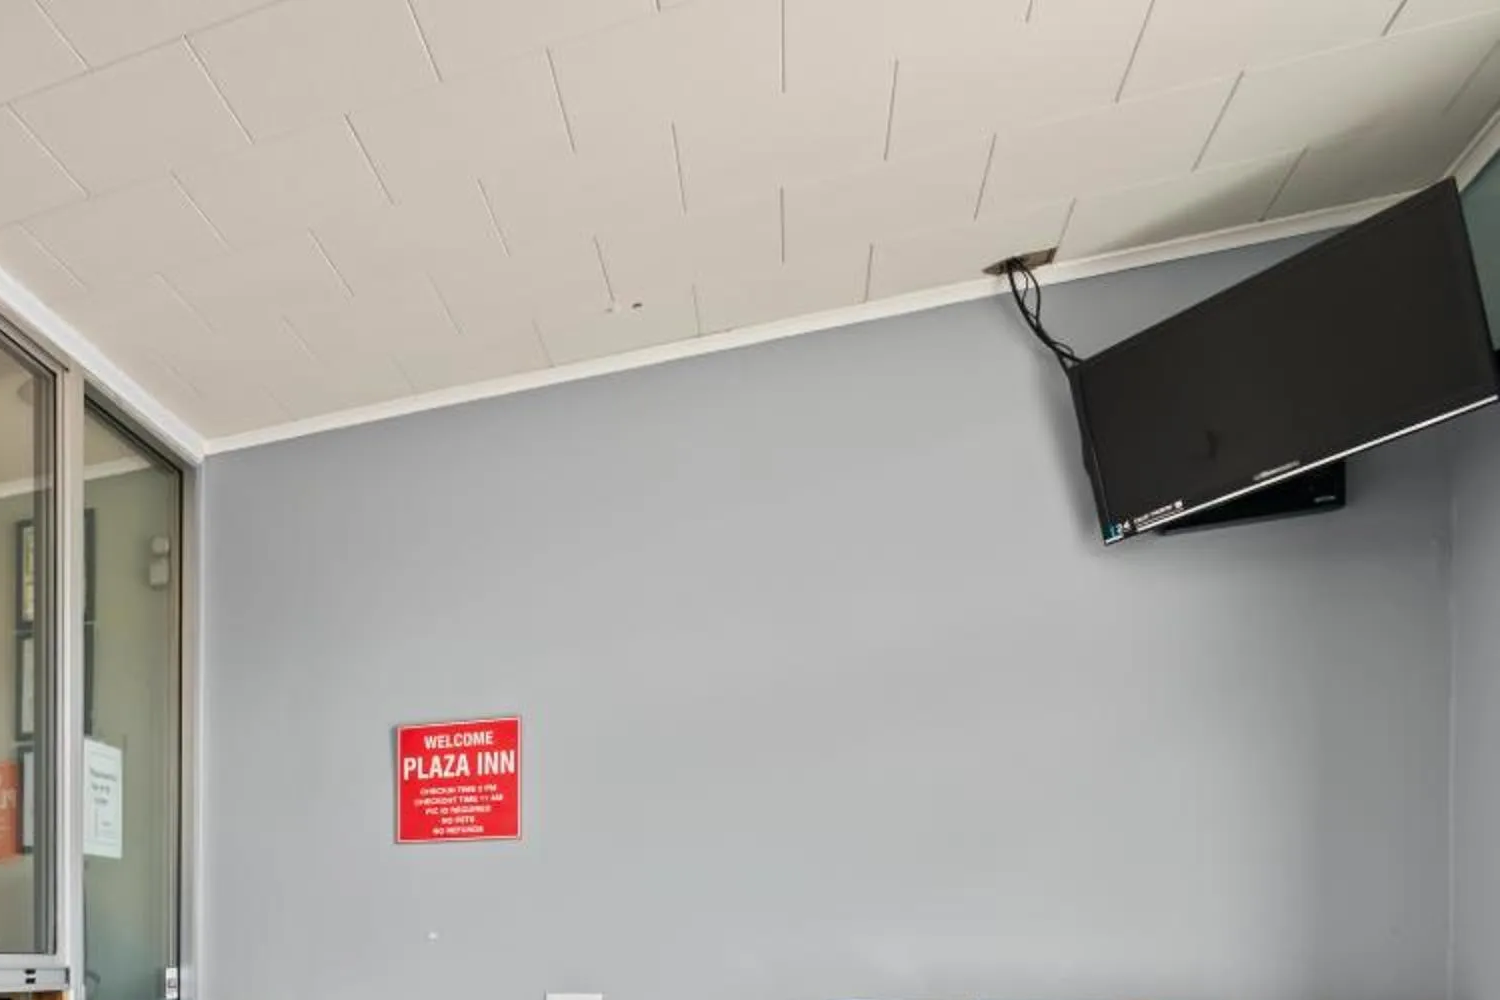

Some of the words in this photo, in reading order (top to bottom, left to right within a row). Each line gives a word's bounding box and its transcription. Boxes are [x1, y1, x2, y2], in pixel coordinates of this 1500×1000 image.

[424, 731, 494, 749] WELCOME
[403, 753, 470, 781] PLAZA
[477, 750, 515, 776] INN
